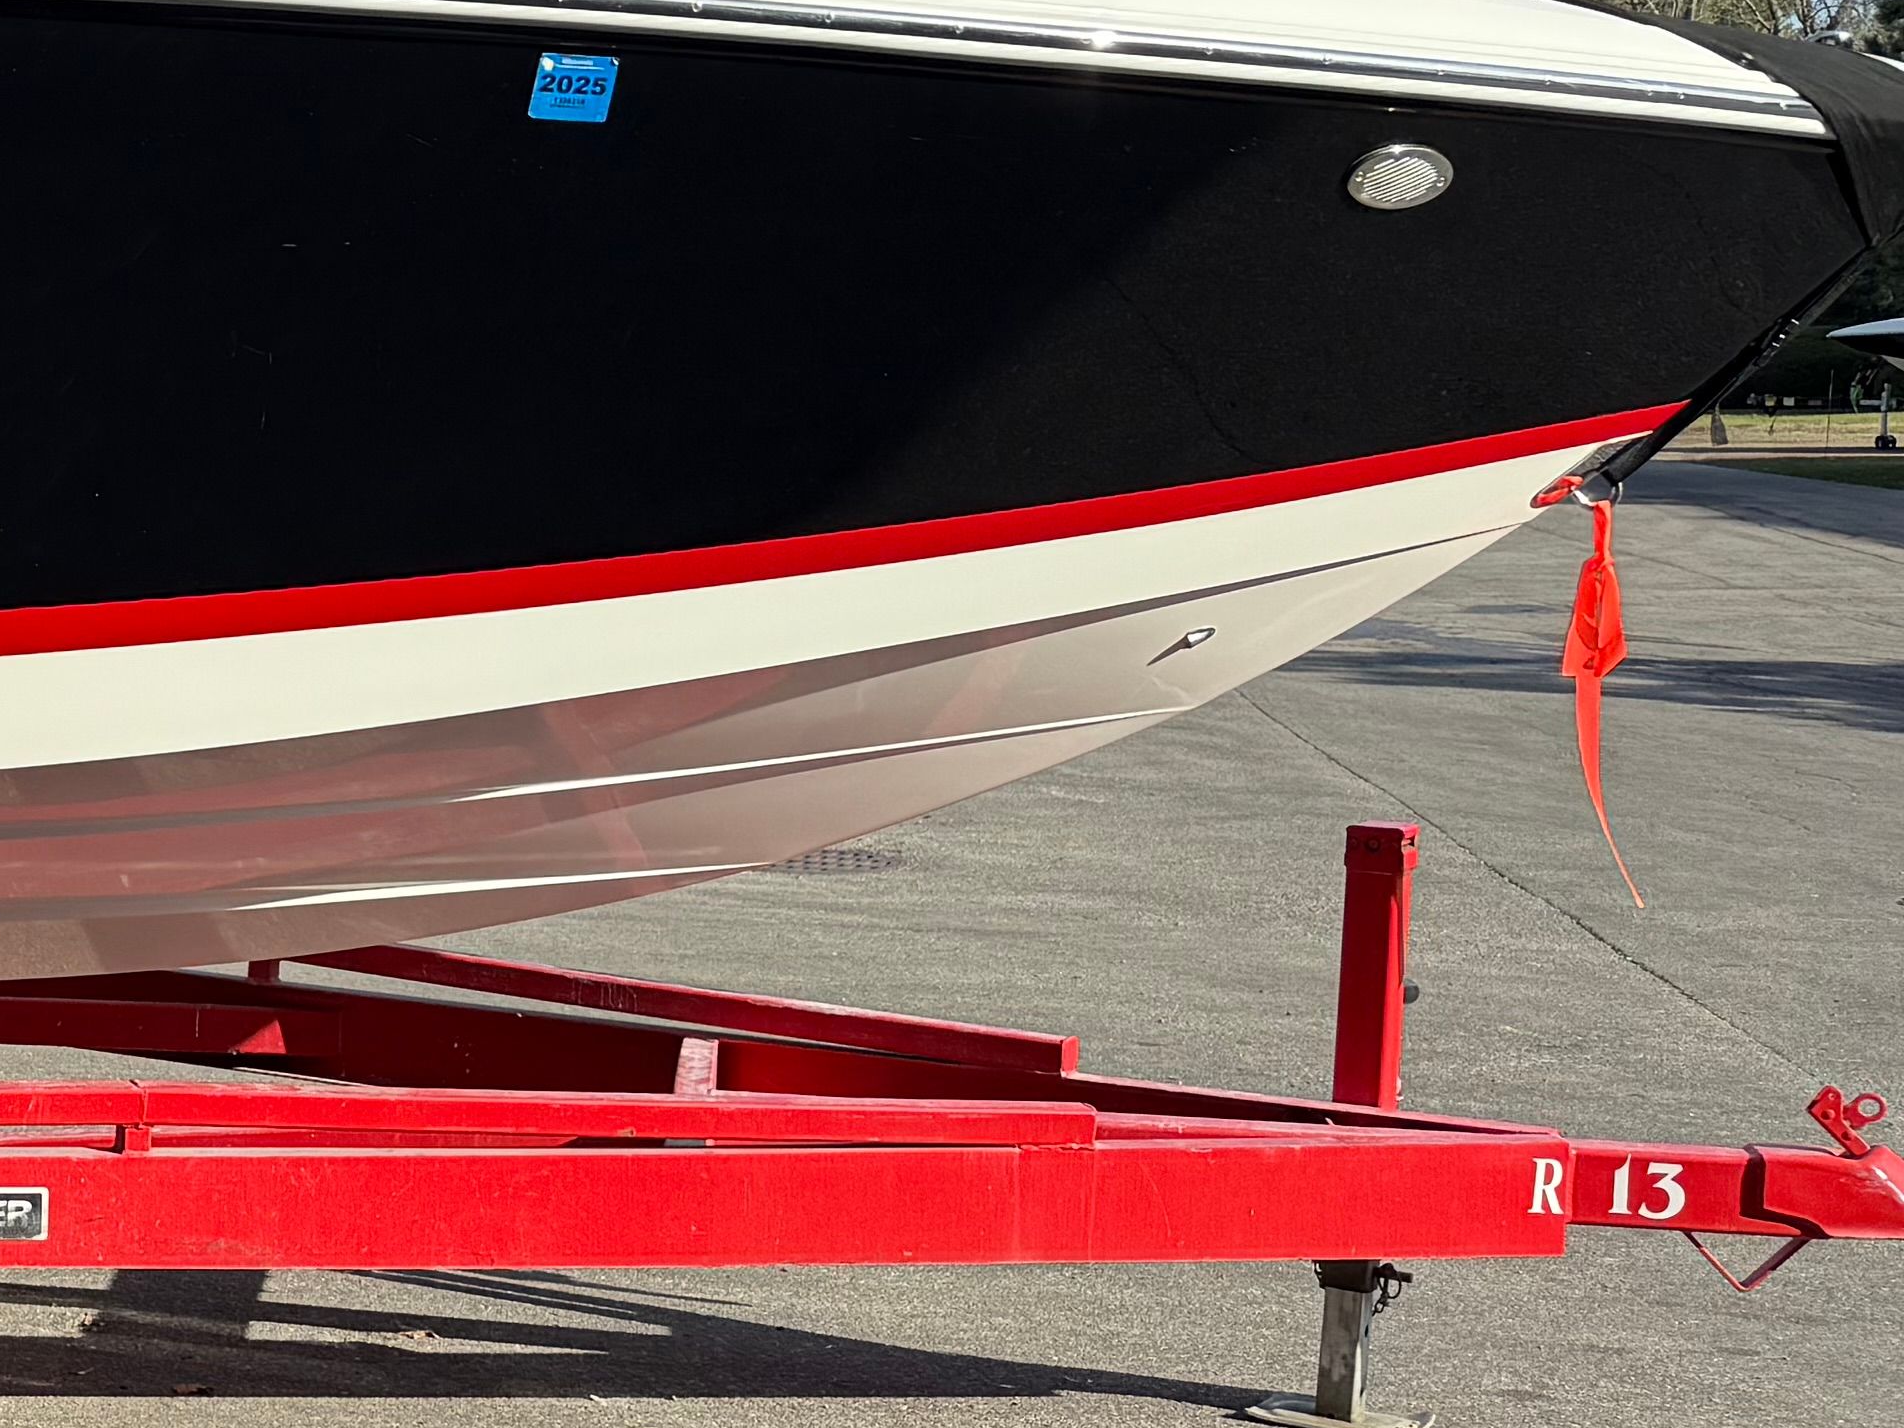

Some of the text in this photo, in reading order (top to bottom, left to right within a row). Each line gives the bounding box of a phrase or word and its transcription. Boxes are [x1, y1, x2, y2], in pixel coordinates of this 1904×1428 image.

[539, 73, 608, 96] 2025
[1527, 1153, 1686, 1220] R 13
